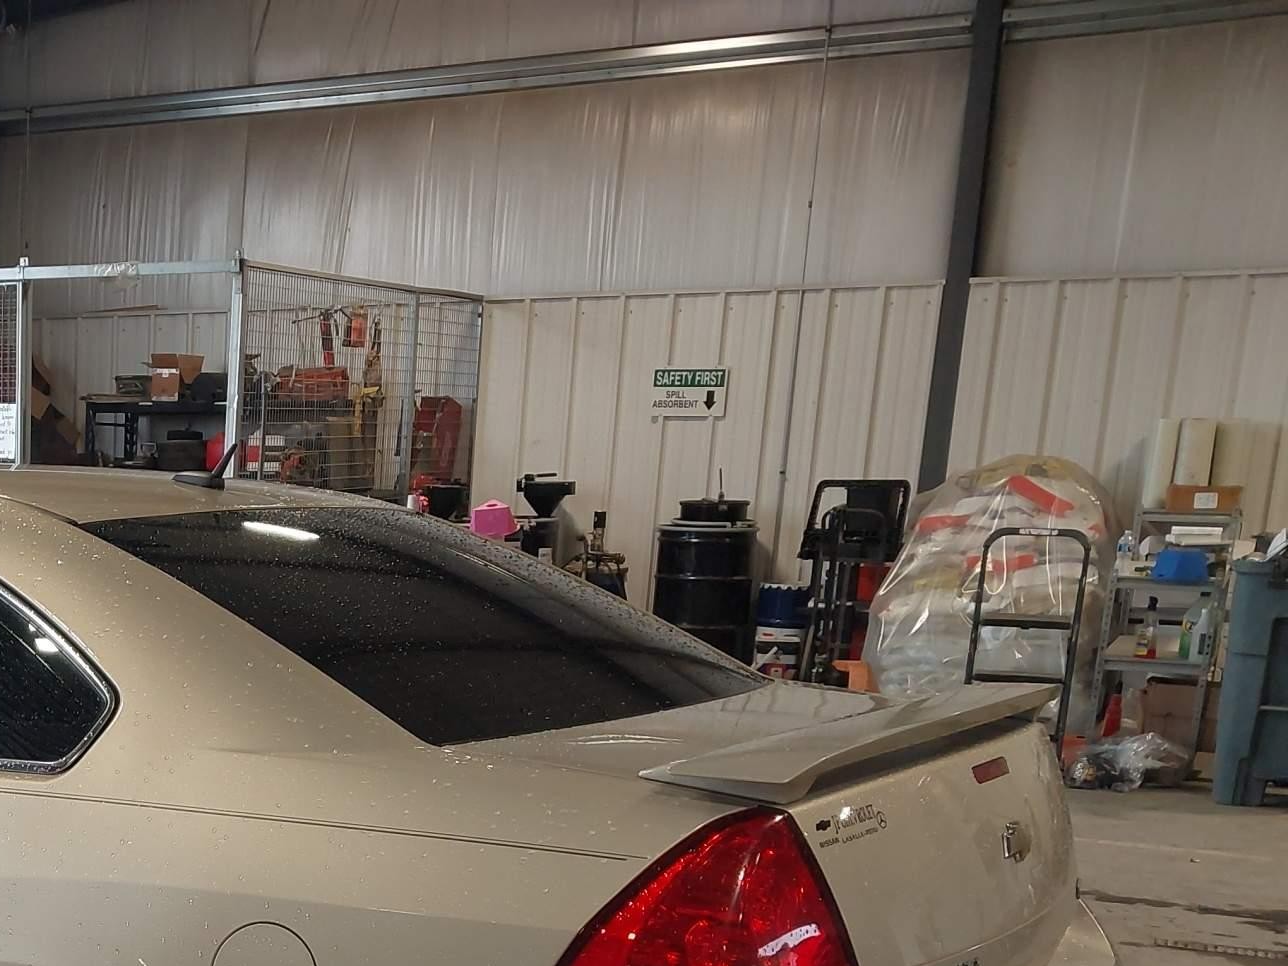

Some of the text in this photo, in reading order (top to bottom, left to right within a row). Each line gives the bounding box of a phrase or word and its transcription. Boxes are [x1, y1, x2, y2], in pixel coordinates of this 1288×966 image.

[656, 371, 723, 386] SAFETY FIRST
[665, 390, 687, 399] SPILL
[652, 400, 699, 409] ABSORBENT
